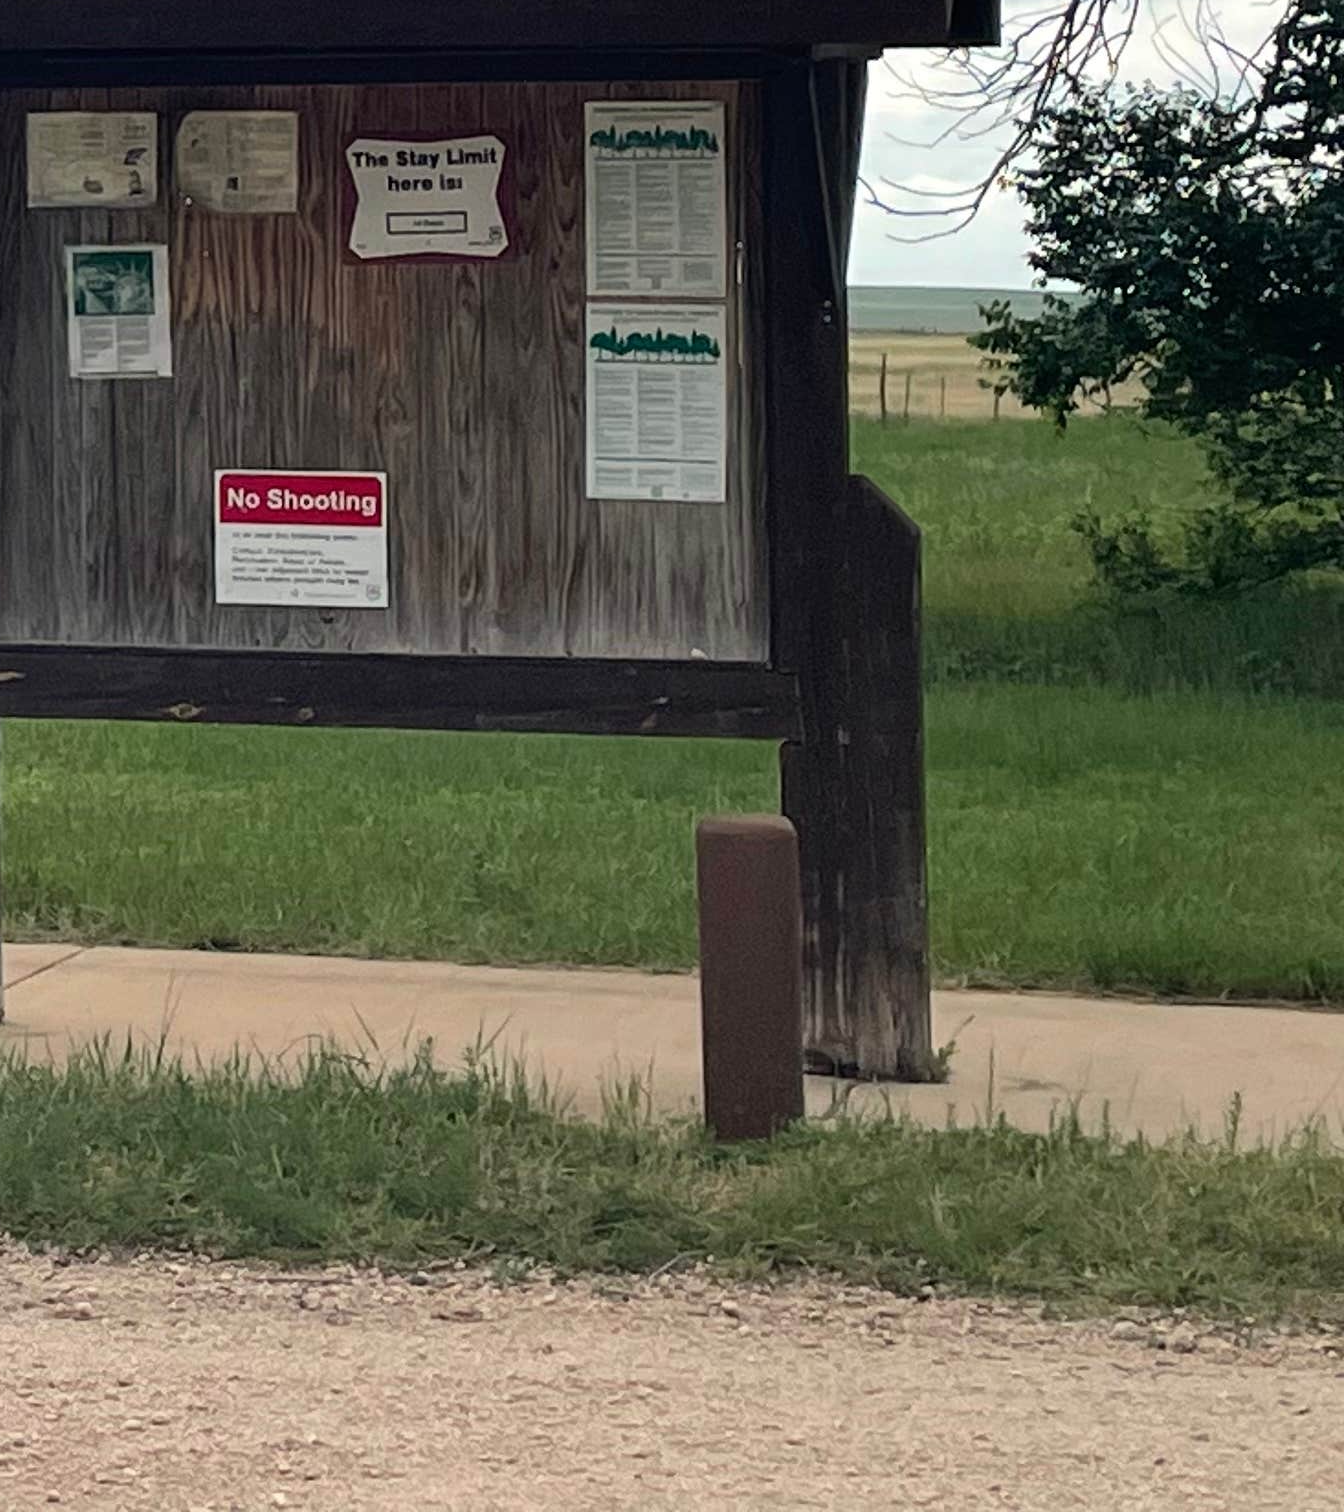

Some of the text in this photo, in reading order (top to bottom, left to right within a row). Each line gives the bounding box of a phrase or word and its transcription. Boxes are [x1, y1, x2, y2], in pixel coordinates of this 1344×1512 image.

[352, 148, 497, 169] The Stay Limit
[387, 173, 462, 192] here is:
[226, 487, 377, 517] No Shooting
